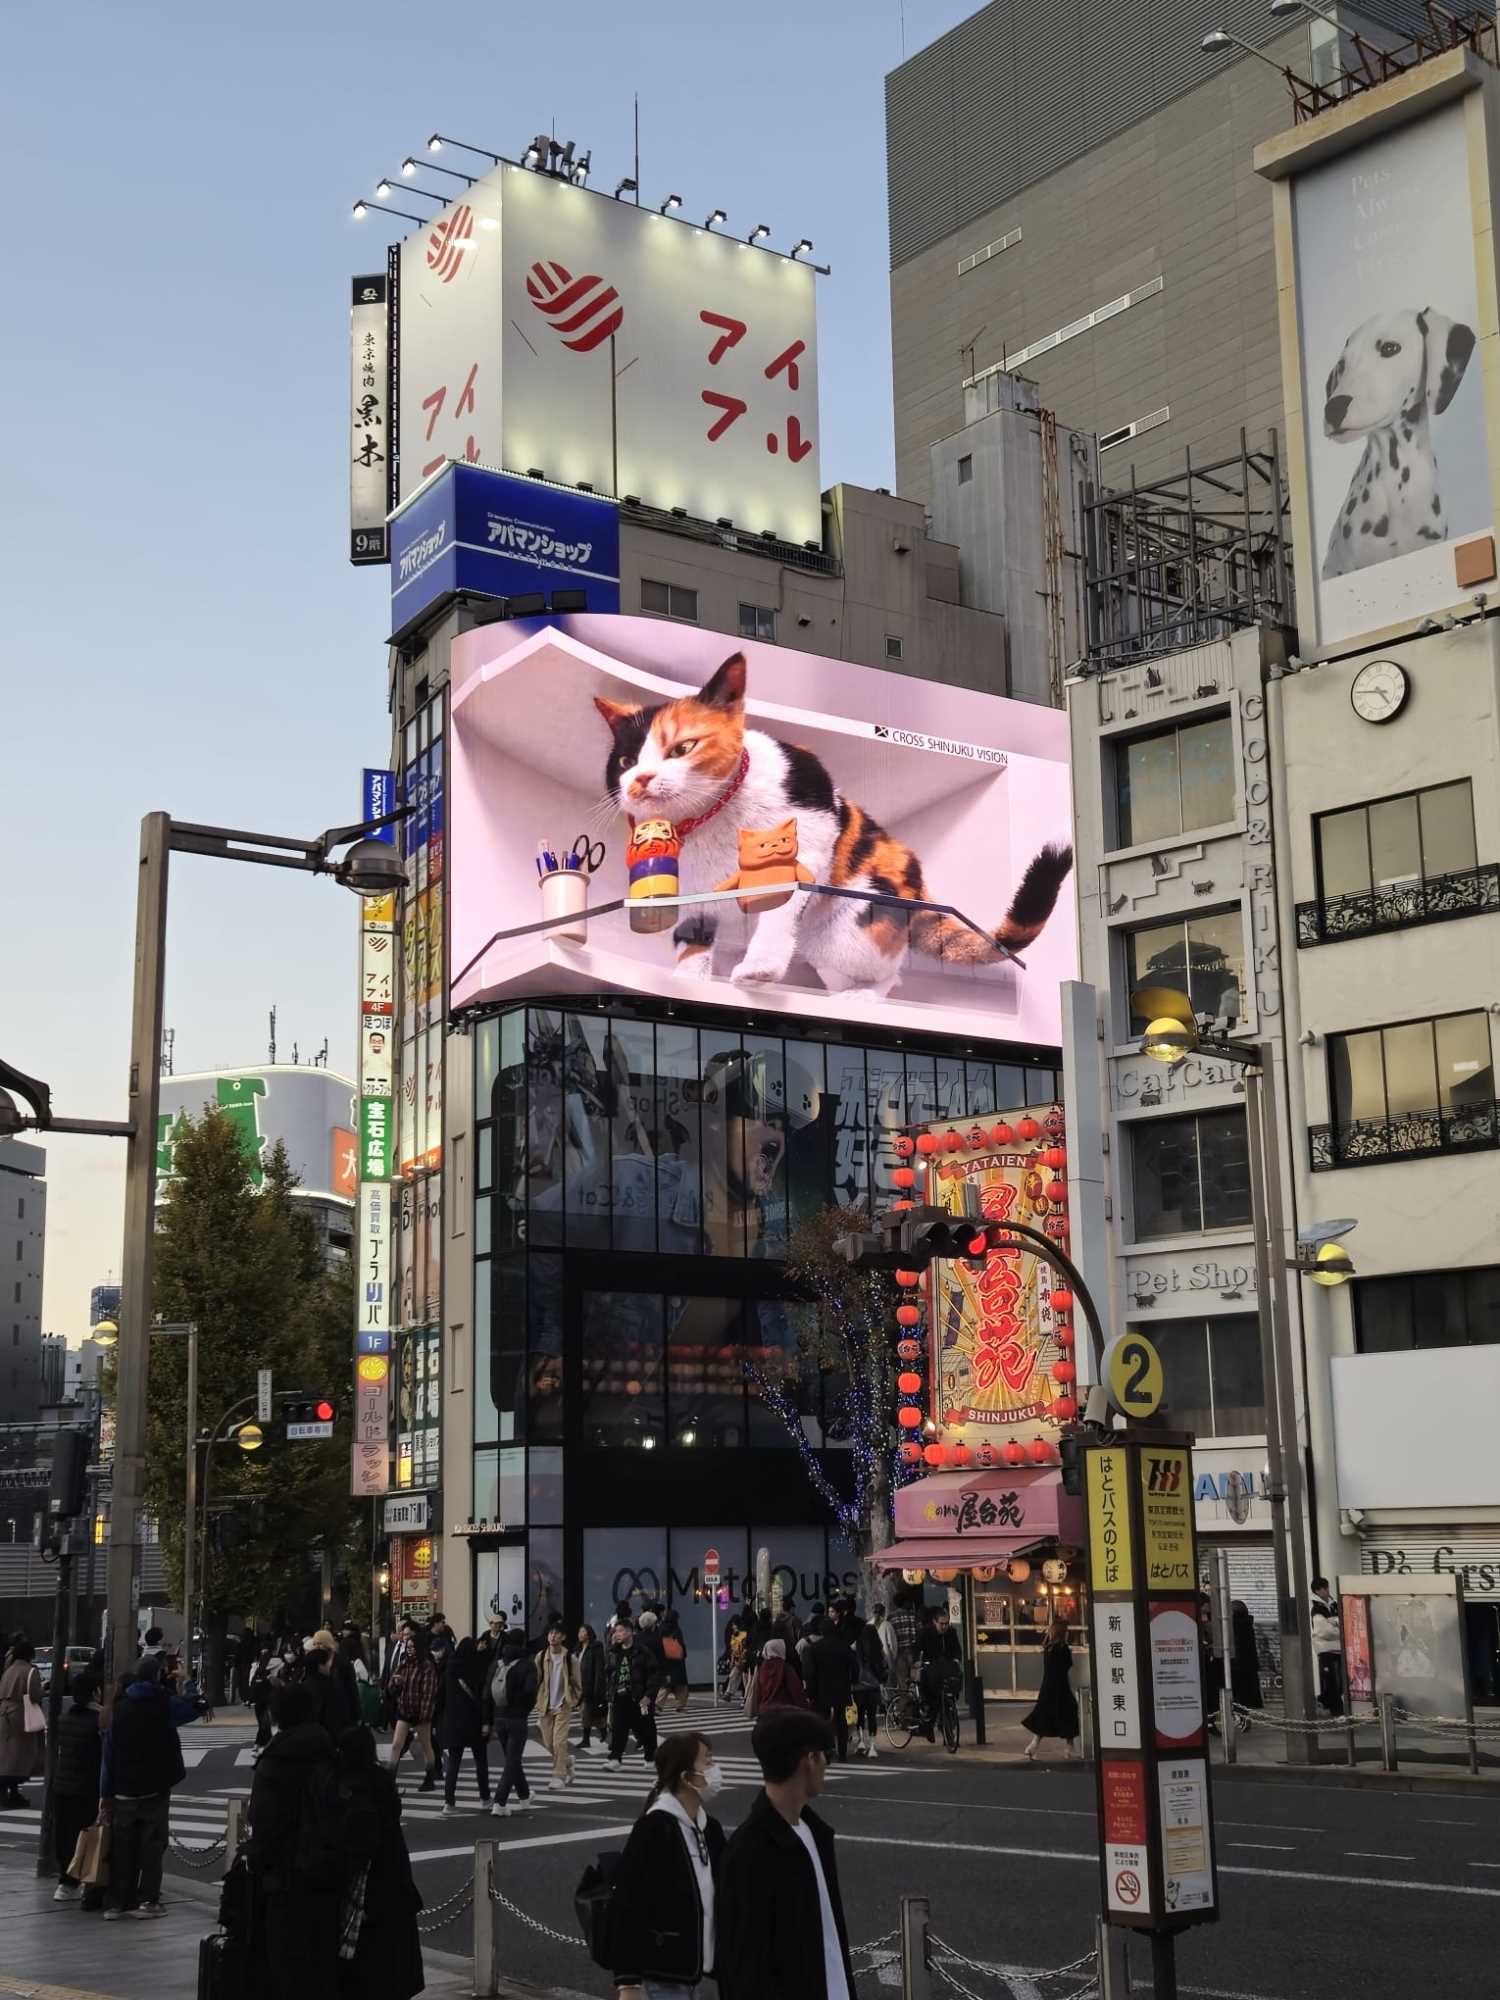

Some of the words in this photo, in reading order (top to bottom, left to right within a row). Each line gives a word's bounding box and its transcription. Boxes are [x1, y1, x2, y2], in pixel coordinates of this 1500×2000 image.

[487, 521, 593, 564] アパマンショップ
[892, 730, 925, 748] CROSS
[927, 738, 974, 758] SHINJUKU
[976, 749, 1008, 764] VISION
[367, 1102, 385, 1177] 宝石広場
[962, 1156, 1028, 1174] YATAIEN
[1127, 1268, 1181, 1294] Pet
[368, 1335, 383, 1349] 1F
[1121, 1343, 1153, 1404] 2
[968, 1406, 1037, 1422] SHINJUKU
[956, 1491, 1026, 1535] 屋台苑
[1099, 1456, 1120, 1583] はとバスのりば
[769, 1564, 862, 1602] Ques
[1151, 1563, 1189, 1579] はとバス
[1108, 1615, 1127, 1737] 新宿駅東口
